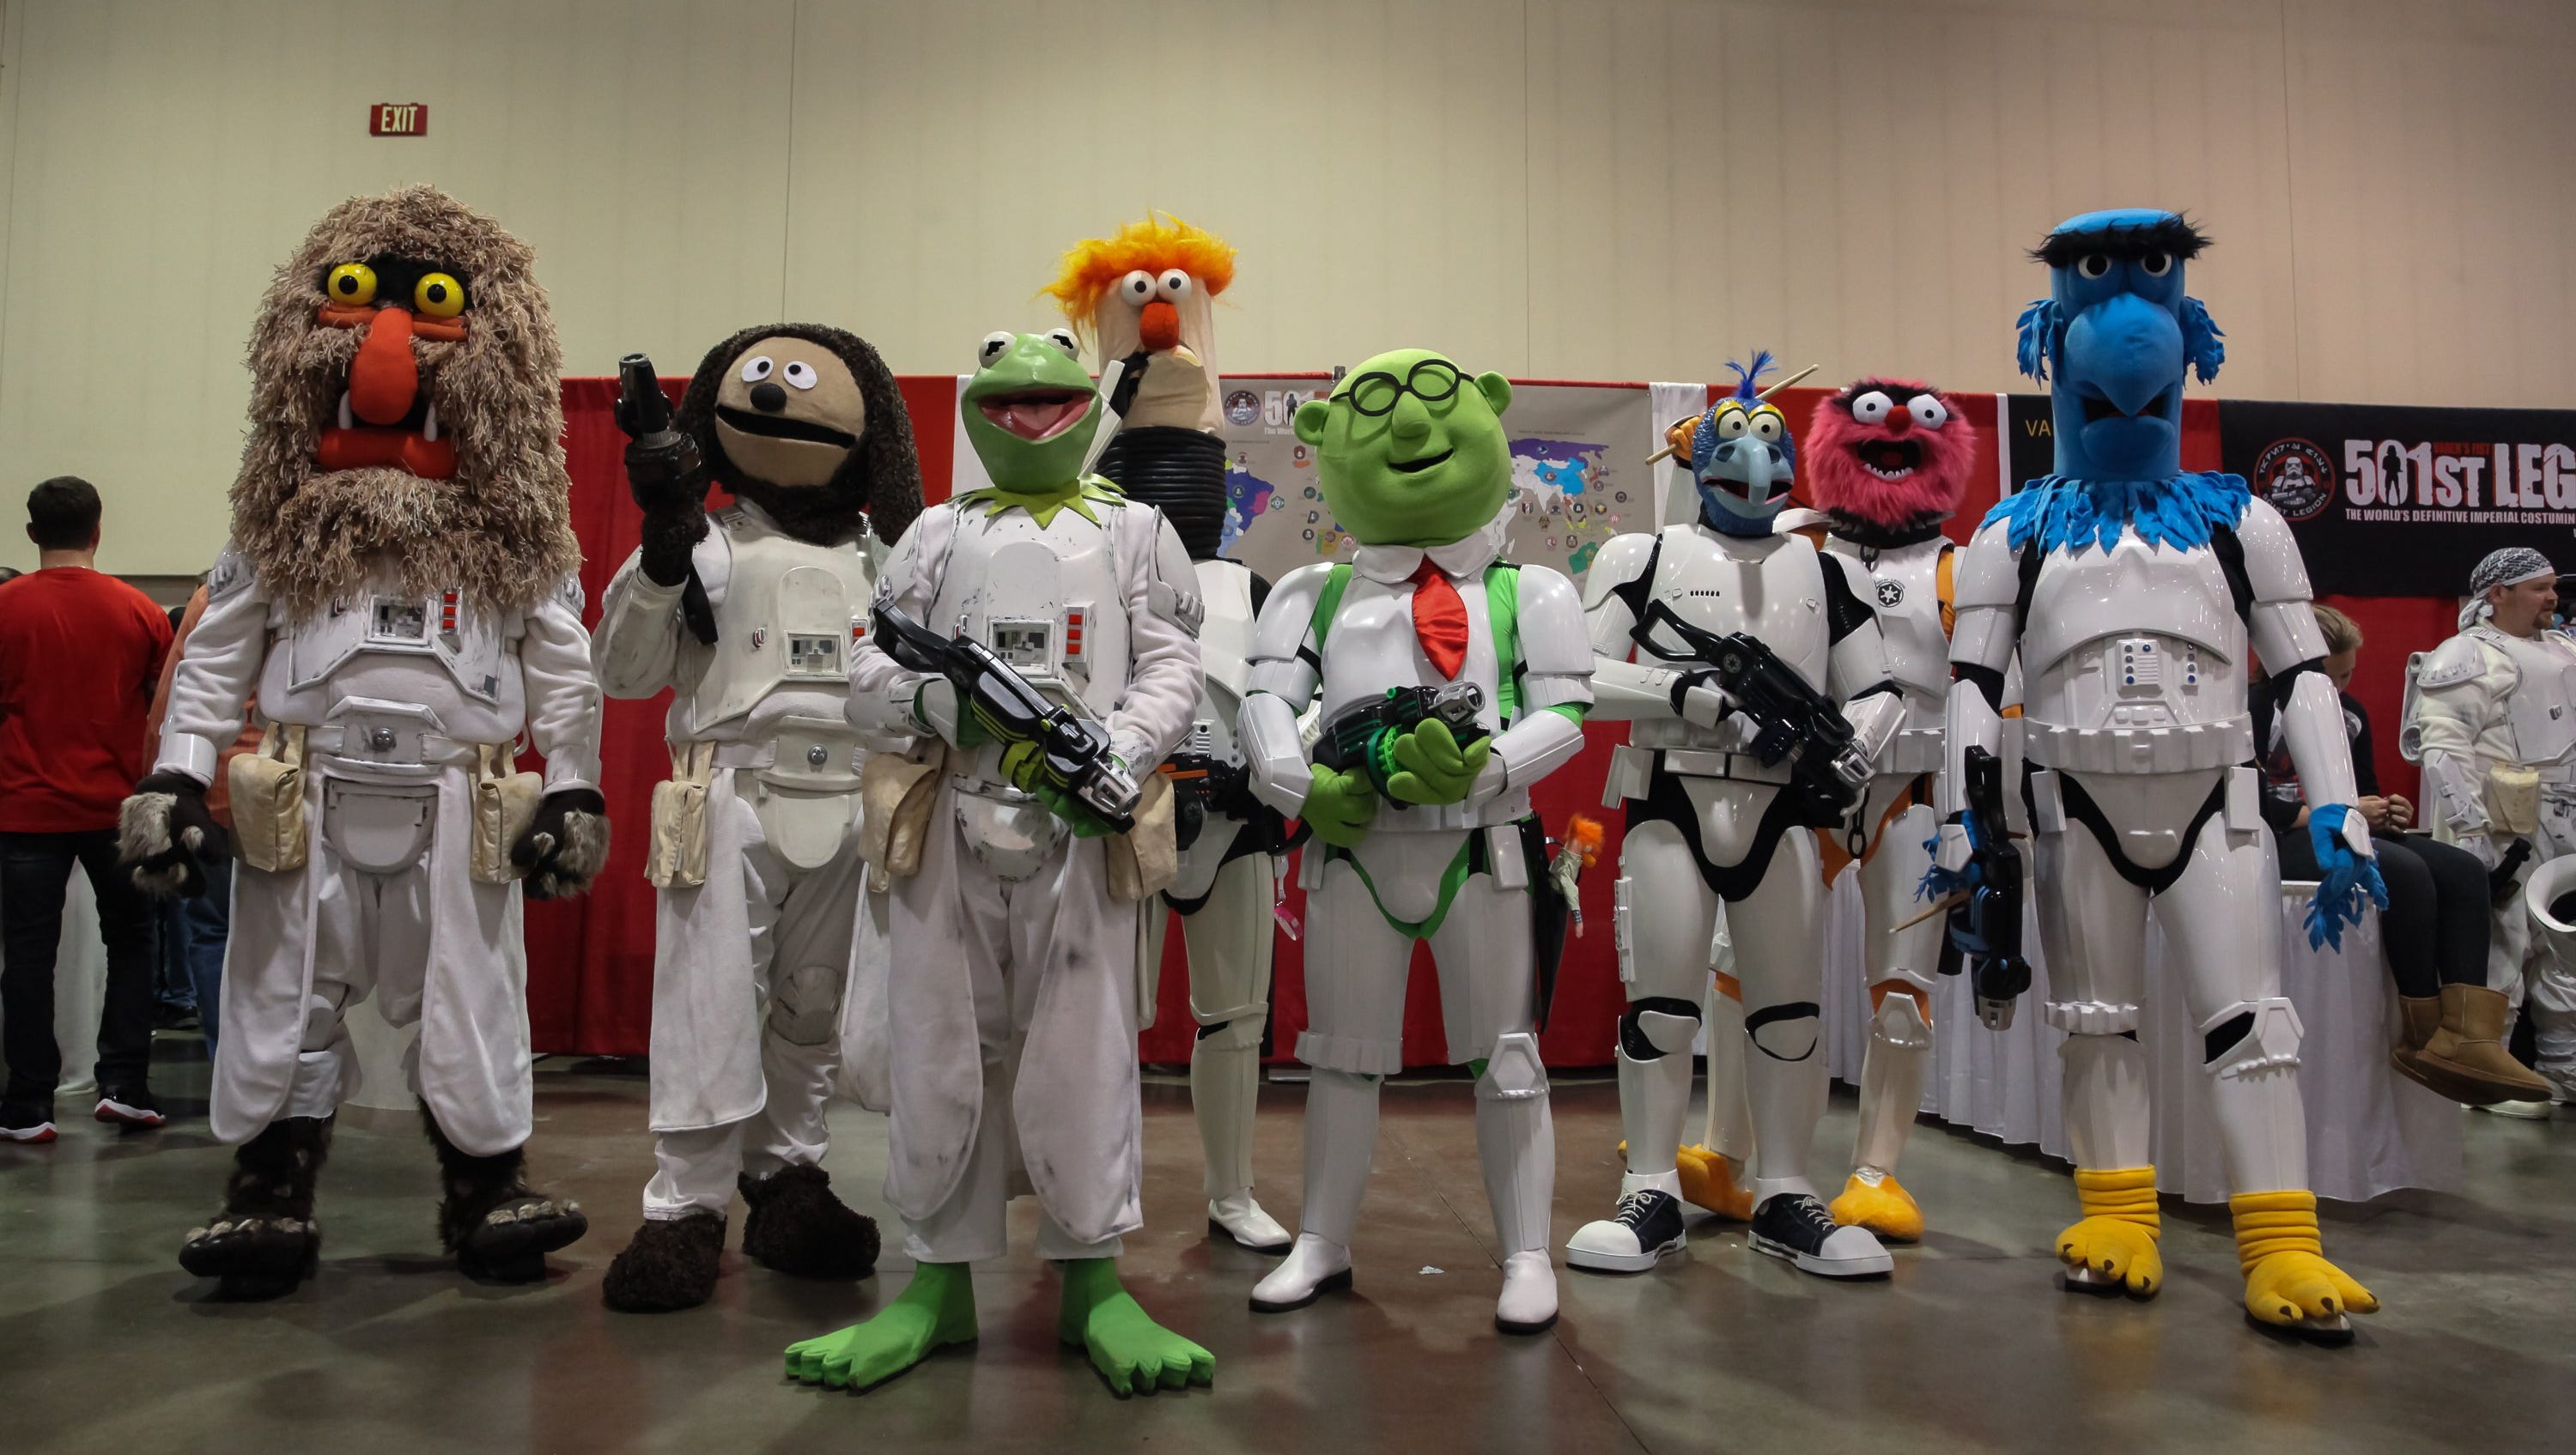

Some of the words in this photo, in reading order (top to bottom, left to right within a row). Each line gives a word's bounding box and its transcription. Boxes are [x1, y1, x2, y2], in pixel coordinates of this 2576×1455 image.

[380, 106, 418, 132] EXIT
[2026, 419, 2051, 437] VA
[2492, 443, 2576, 510] LEG
[2293, 493, 2327, 517] LEGION
[2345, 508, 2361, 521] THE
[2364, 509, 2410, 522] WORLD'S
[2412, 510, 2468, 523] DEFINITIVE
[2470, 512, 2519, 524] IMPERIAL
[2520, 512, 2576, 524] COSTUMIN
